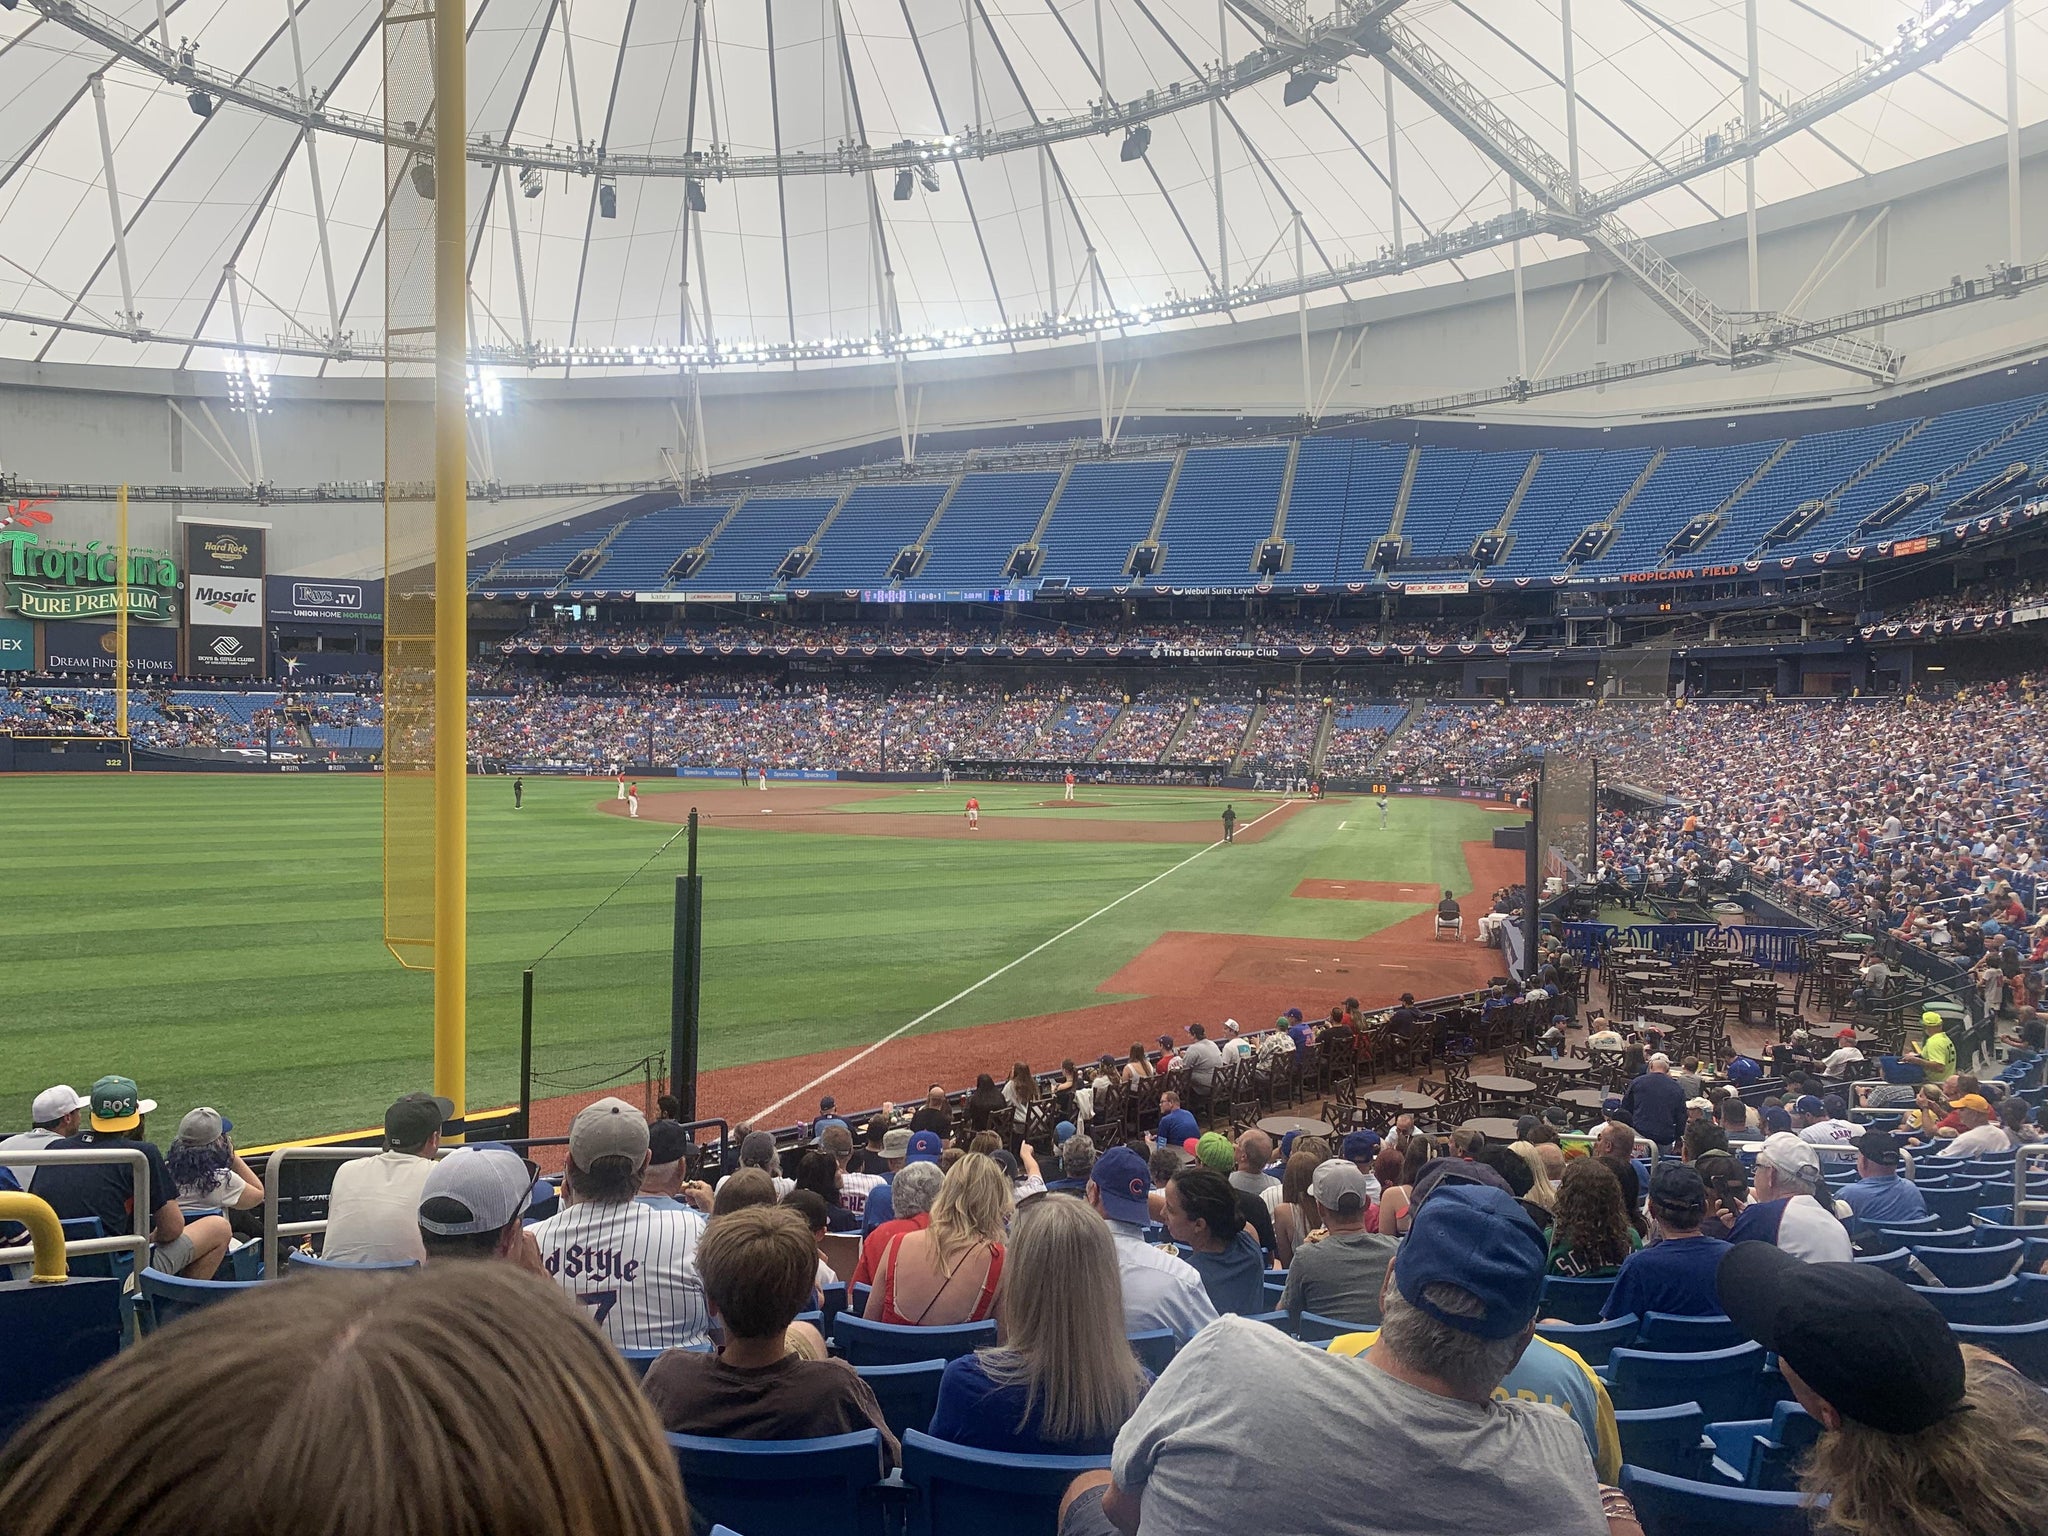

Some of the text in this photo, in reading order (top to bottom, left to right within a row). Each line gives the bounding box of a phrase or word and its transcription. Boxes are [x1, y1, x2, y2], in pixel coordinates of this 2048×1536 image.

[204, 541, 248, 554] Hard Rock
[0, 531, 177, 587] Tropicana
[1622, 570, 1694, 583] TROPICANA
[1702, 566, 1738, 577] FIELD
[195, 587, 257, 603] Mosaic
[1184, 587, 1210, 595] Webull
[1234, 586, 1254, 594] Level
[21, 592, 157, 612] PURE PREMIUM
[342, 612, 382, 620] MORTGAGE
[0, 639, 22, 650] EX
[1224, 650, 1254, 658] Group
[50, 656, 173, 669] DREAM FINDES HOMES
[916, 1140, 927, 1151] C
[1130, 1178, 1144, 1195] C
[565, 1244, 639, 1282] Style
